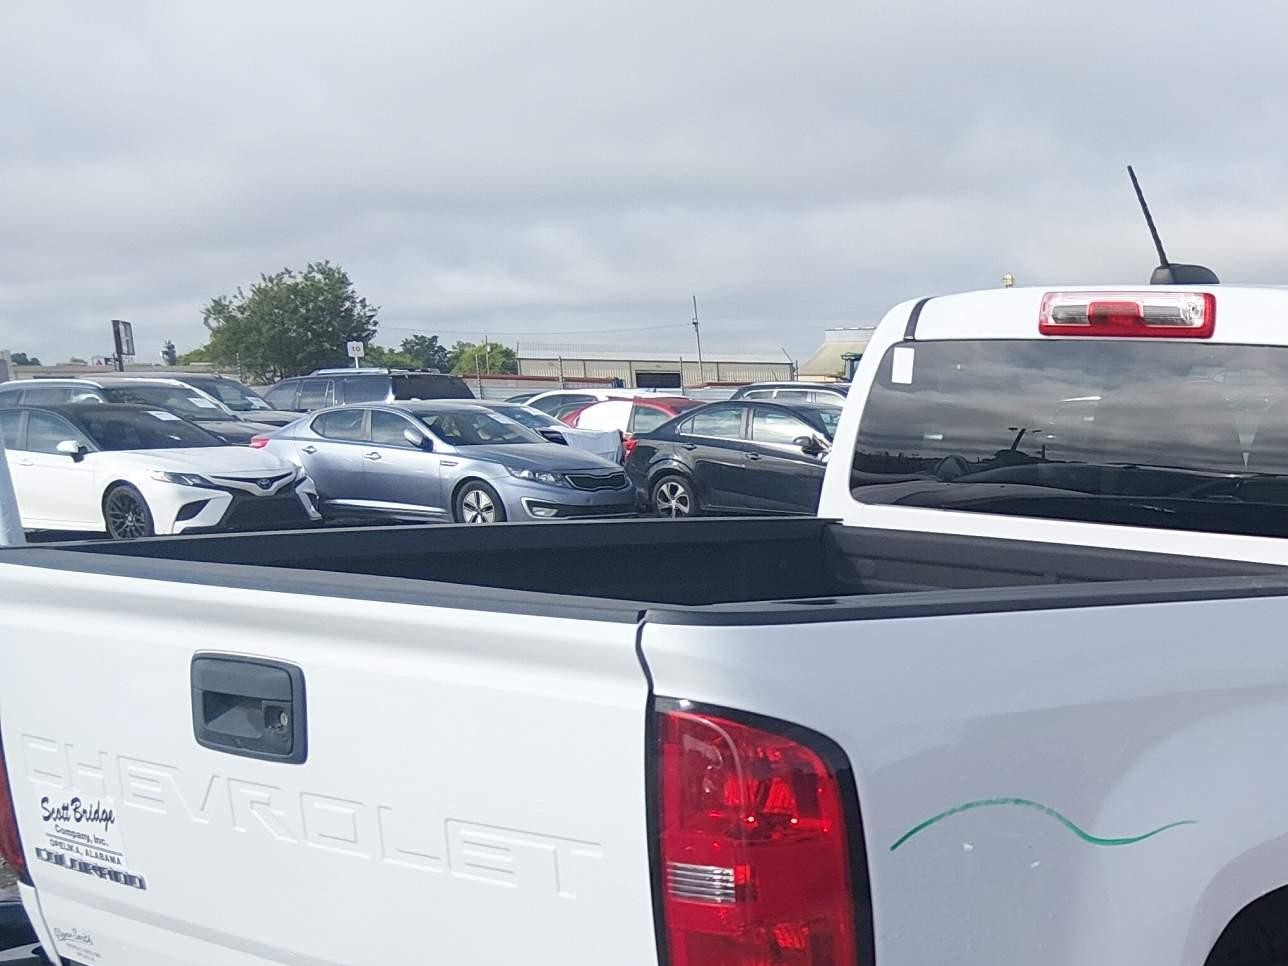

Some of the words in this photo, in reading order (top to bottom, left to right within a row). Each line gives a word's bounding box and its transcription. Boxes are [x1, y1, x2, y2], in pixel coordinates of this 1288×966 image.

[21, 734, 604, 899] CHEVROLET
[41, 796, 72, 822] Scott
[71, 796, 116, 833] Bridge
[54, 823, 93, 845] Company,
[93, 833, 110, 847] Inc.
[85, 847, 123, 865] ALABAMA
